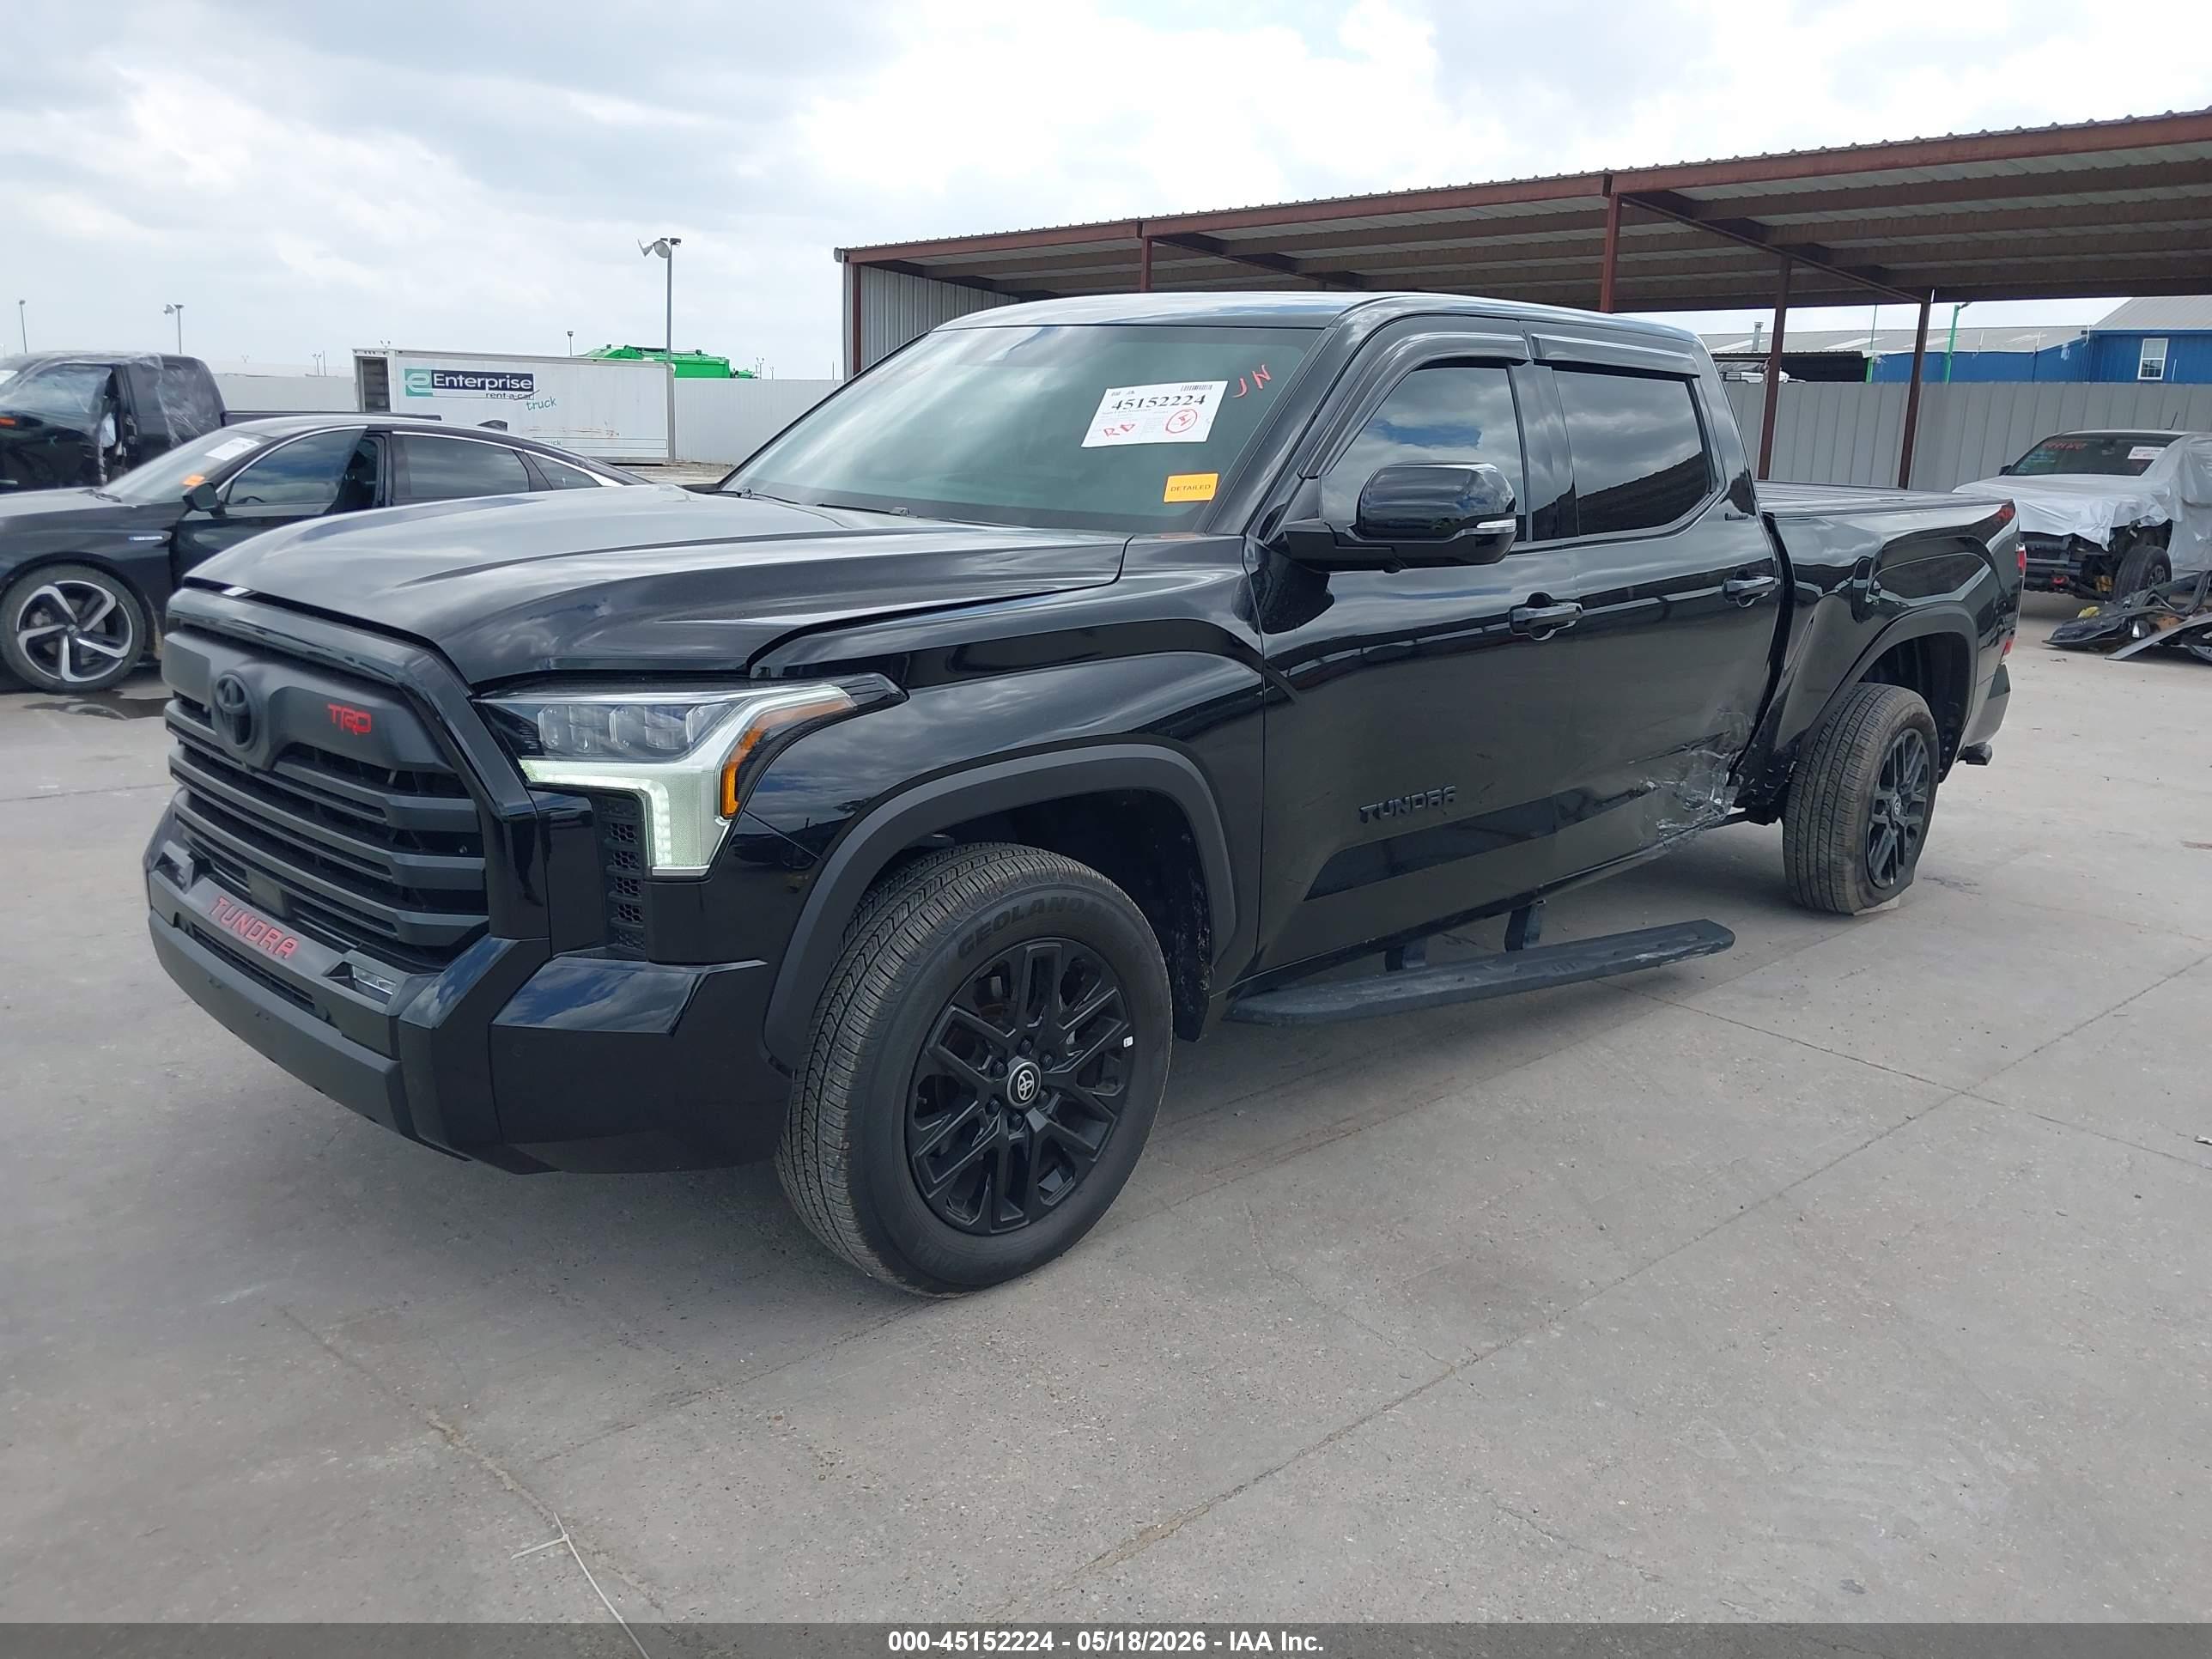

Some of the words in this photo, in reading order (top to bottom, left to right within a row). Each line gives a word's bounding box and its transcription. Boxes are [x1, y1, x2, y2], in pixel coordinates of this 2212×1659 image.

[434, 373, 532, 391] Enterprise
[486, 392, 534, 400] rent-a-car
[526, 396, 557, 411] truck
[1112, 394, 1206, 410] 45152224
[1170, 483, 1211, 493] DETAILED
[328, 703, 372, 735] TRD
[1358, 785, 1456, 823] TUNDRA
[210, 896, 299, 960] TUNDRA
